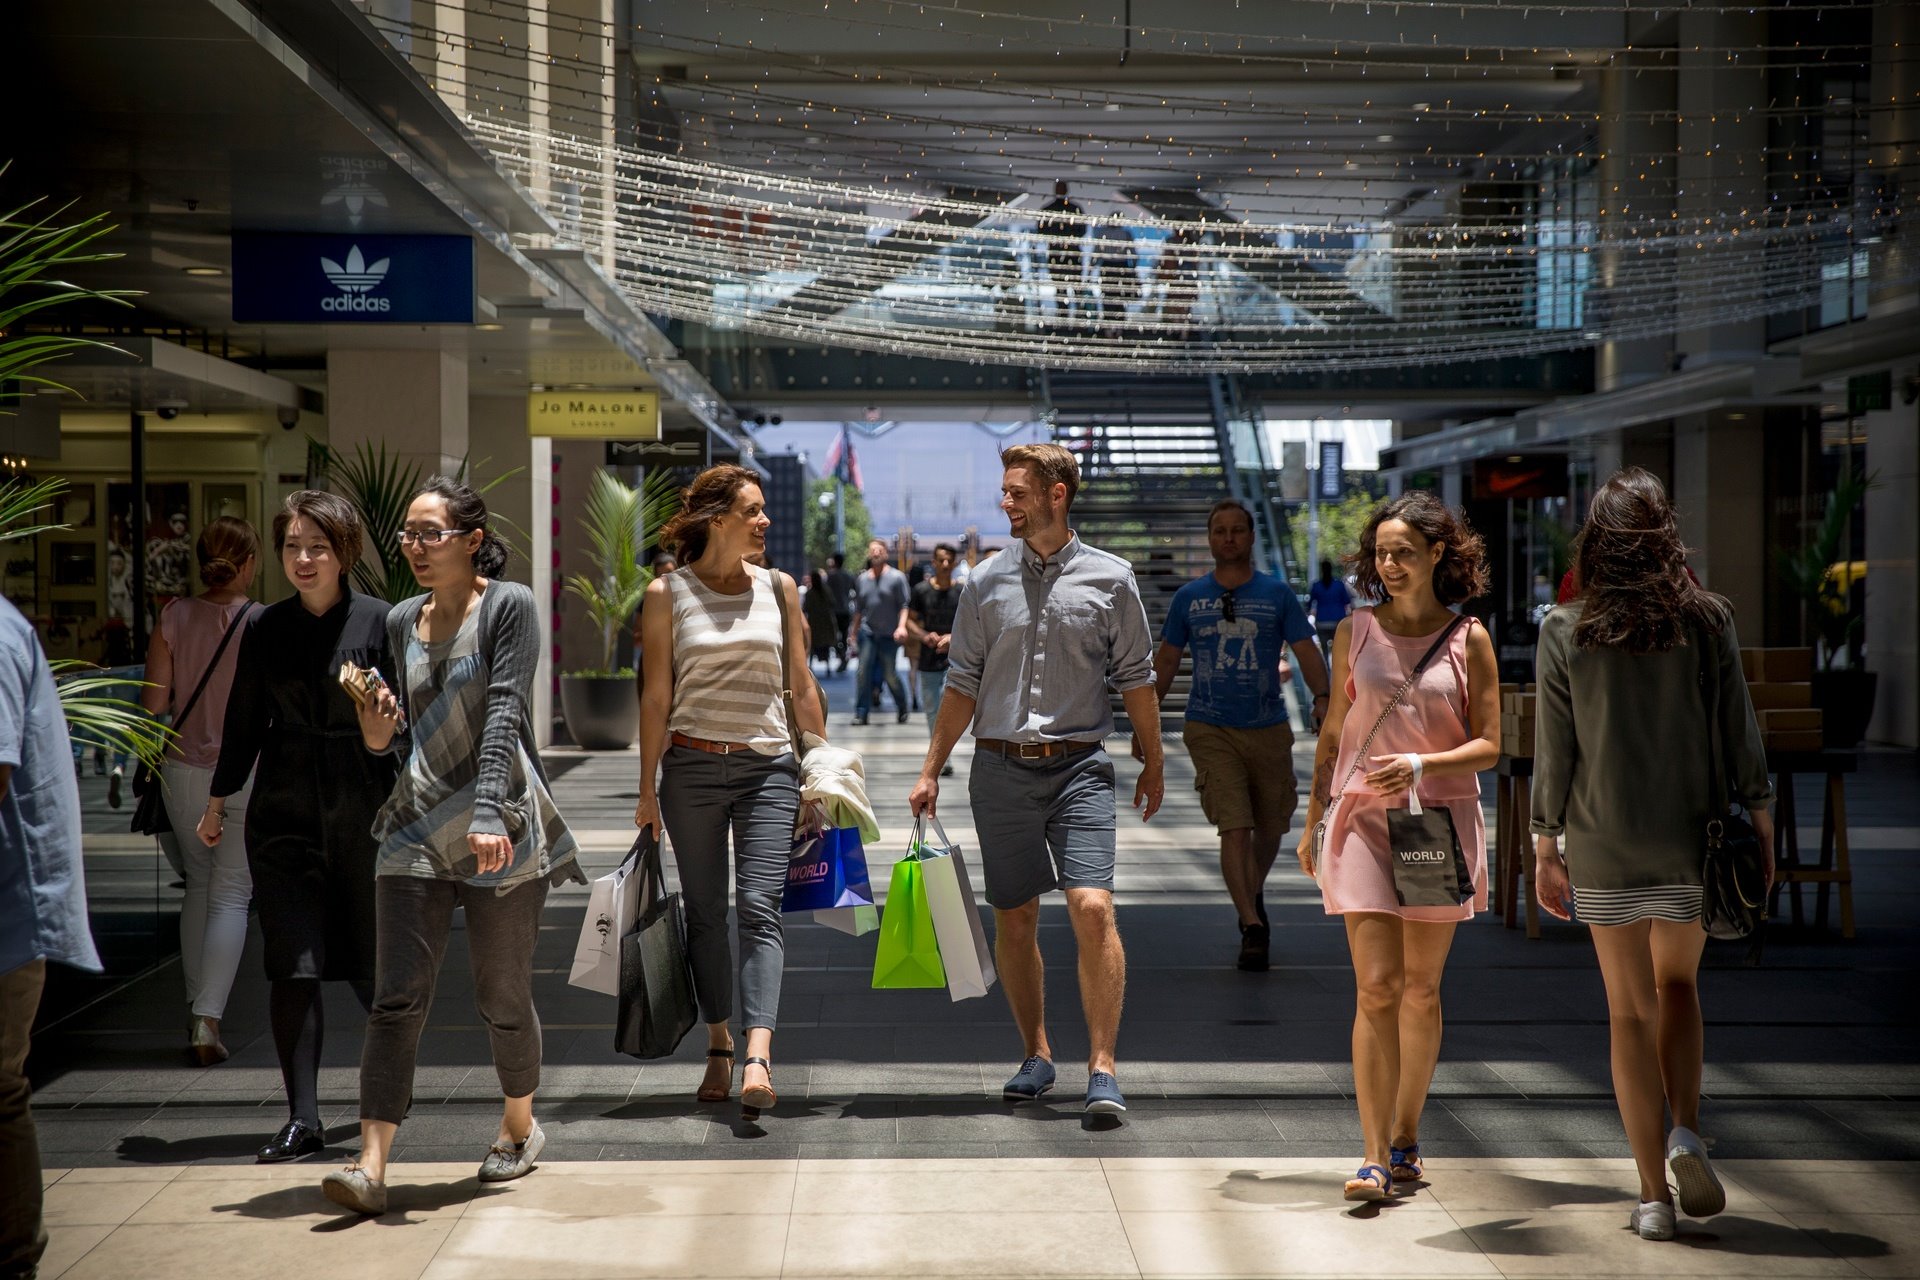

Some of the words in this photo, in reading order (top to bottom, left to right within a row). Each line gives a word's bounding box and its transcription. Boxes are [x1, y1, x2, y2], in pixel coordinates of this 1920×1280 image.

[320, 293, 391, 312] adidas
[569, 400, 648, 413] MALONE
[1189, 597, 1237, 612] AT-A
[1400, 850, 1446, 861] WORLD
[788, 861, 829, 880] WORLD
